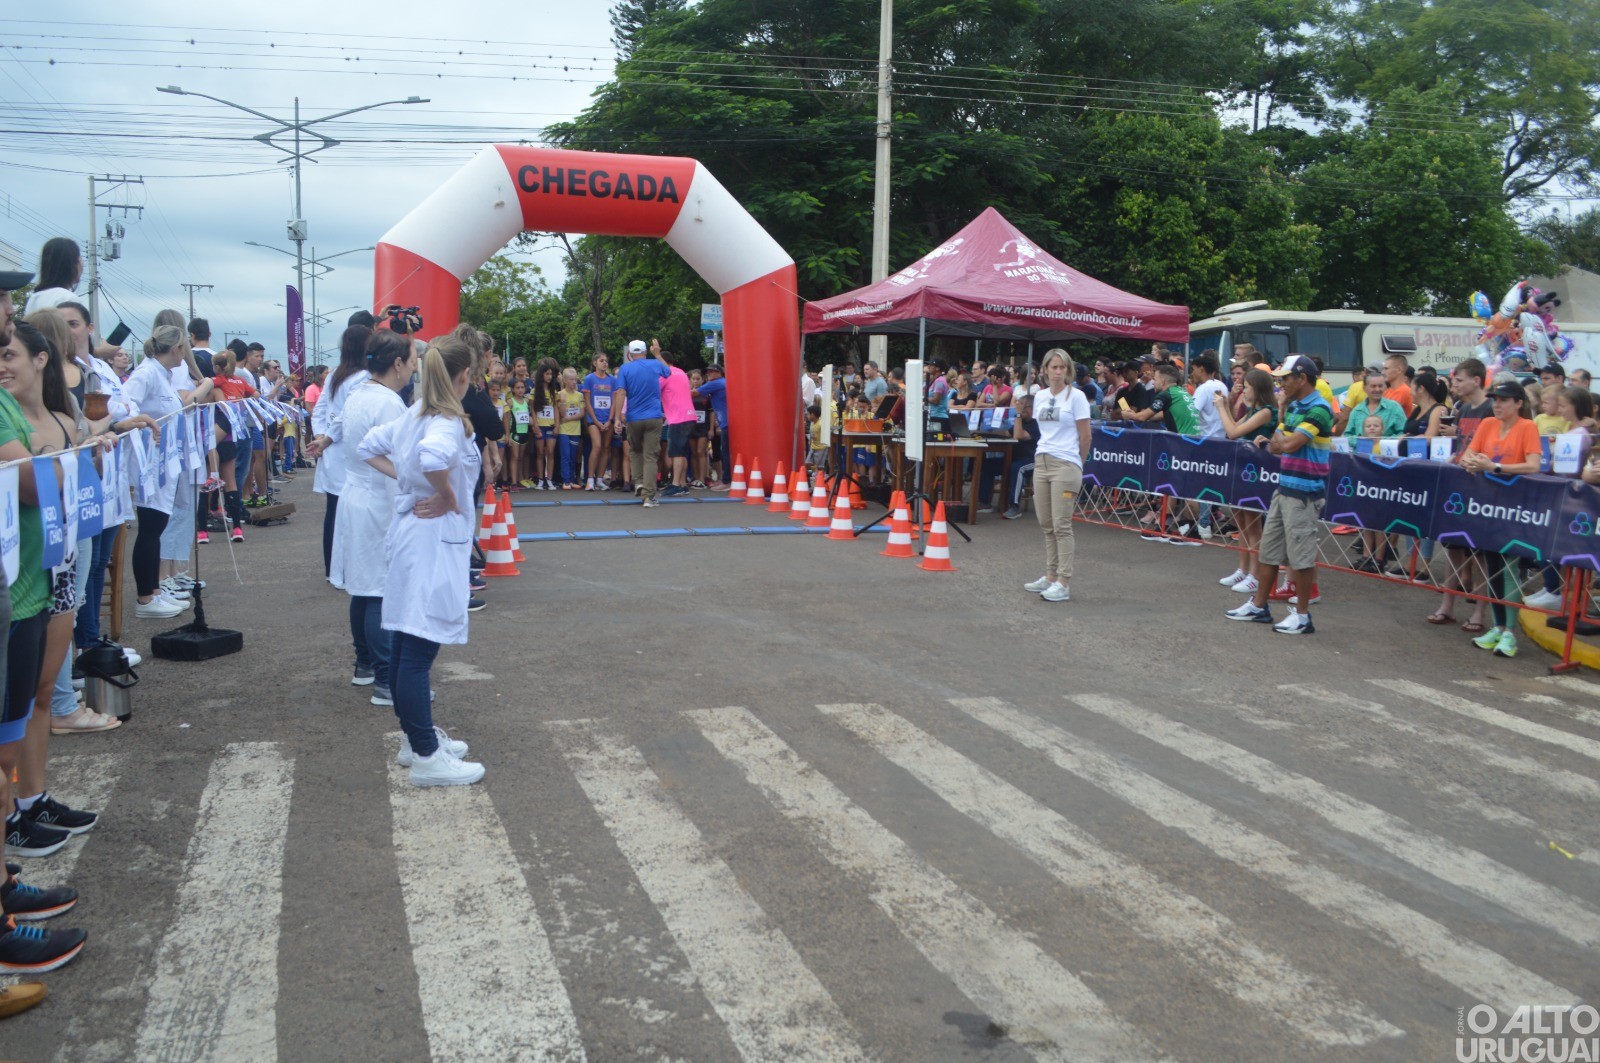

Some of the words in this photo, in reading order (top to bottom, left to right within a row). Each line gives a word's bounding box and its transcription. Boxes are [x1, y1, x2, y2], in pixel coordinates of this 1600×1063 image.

[518, 165, 679, 203] CHEGADA
[1004, 265, 1057, 279] MARATONA
[1027, 274, 1041, 283] DO
[1041, 272, 1070, 285] VINHO
[983, 303, 1143, 327] www.maratonadovinho.com.br
[598, 400, 608, 408] 35
[1093, 448, 1145, 466] banrisul
[1171, 456, 1229, 477] banrisul
[78, 486, 94, 500] AGRO
[1356, 481, 1428, 507] banrisul
[1468, 497, 1551, 527] banrisul
